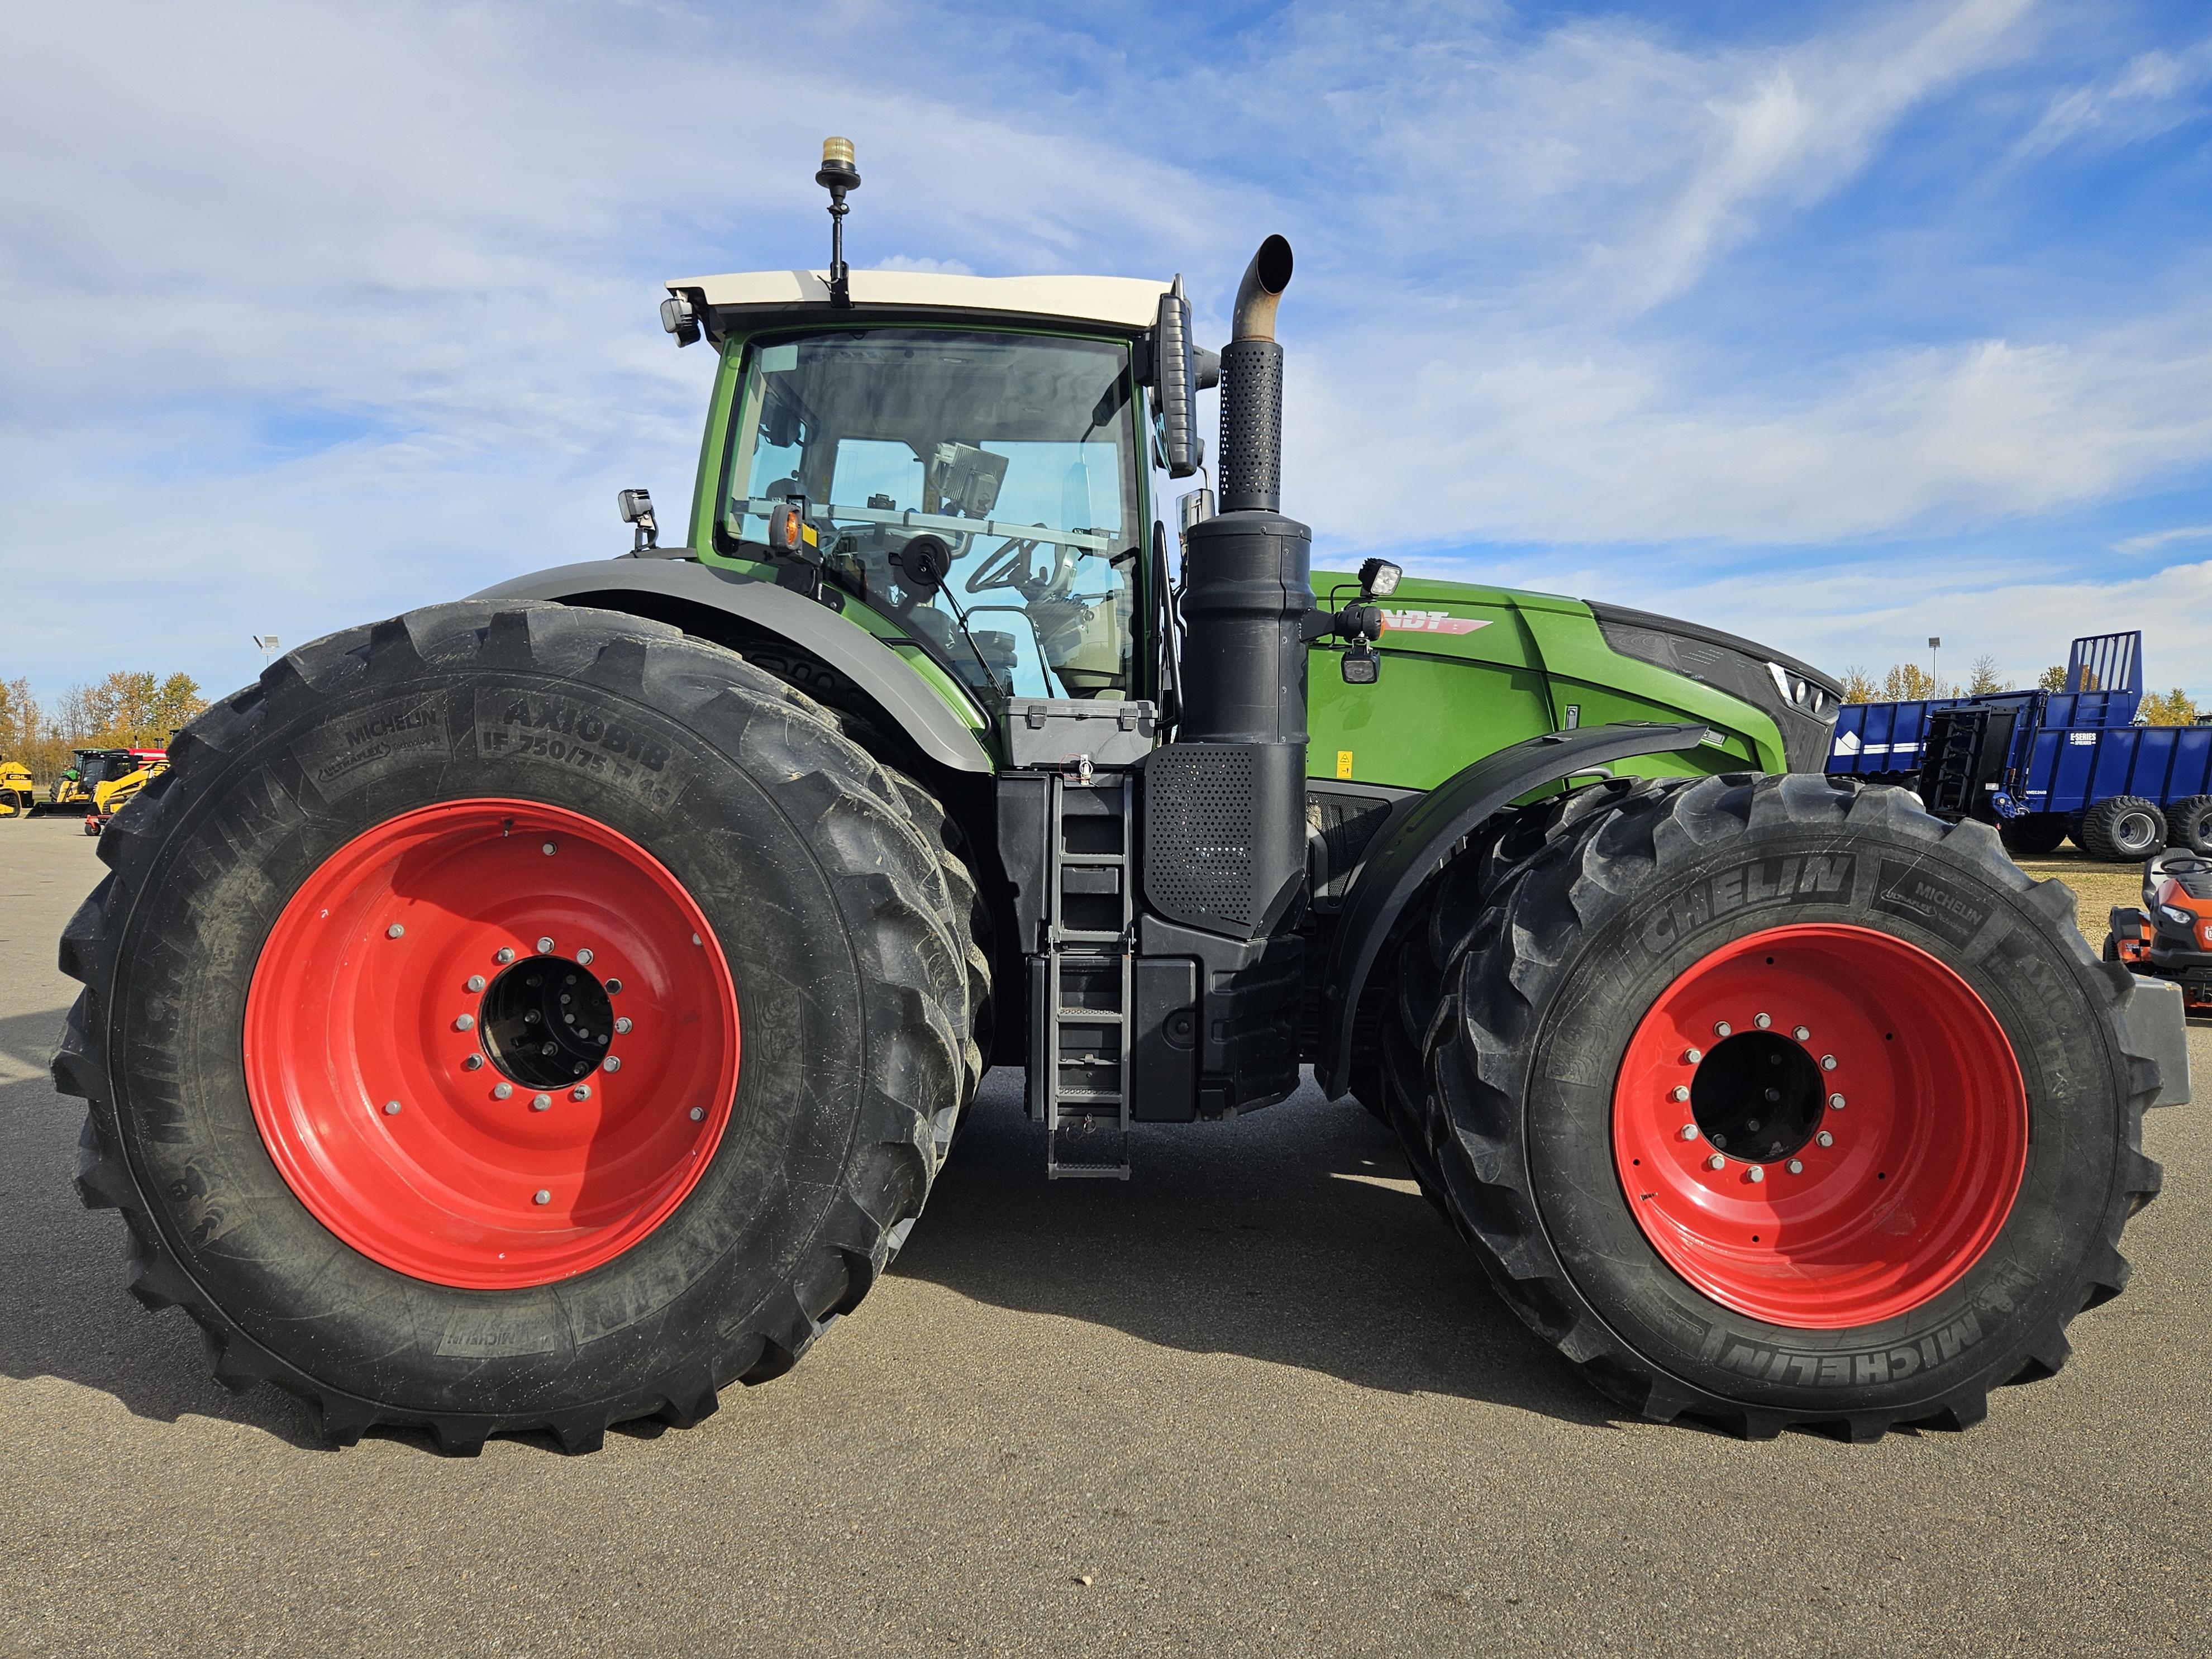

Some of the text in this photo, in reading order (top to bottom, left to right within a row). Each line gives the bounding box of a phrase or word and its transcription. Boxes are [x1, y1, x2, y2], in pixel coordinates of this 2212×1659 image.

[346, 710, 437, 748] MICHELIN
[503, 698, 672, 773] AXIOBIB
[2070, 733, 2096, 741] E-SERIES
[323, 745, 383, 777] ULTRAFLEX
[483, 731, 509, 751] IF
[519, 735, 607, 775] 750/75
[638, 778, 670, 807] 46
[1885, 890, 1932, 916] ULTRAFLEX
[1915, 881, 1983, 925] MICHELIN
[1578, 854, 1851, 1018] MICHELIN
[447, 1331, 515, 1346] MICHELIN
[1718, 1310, 1984, 1386] MICHELIN
